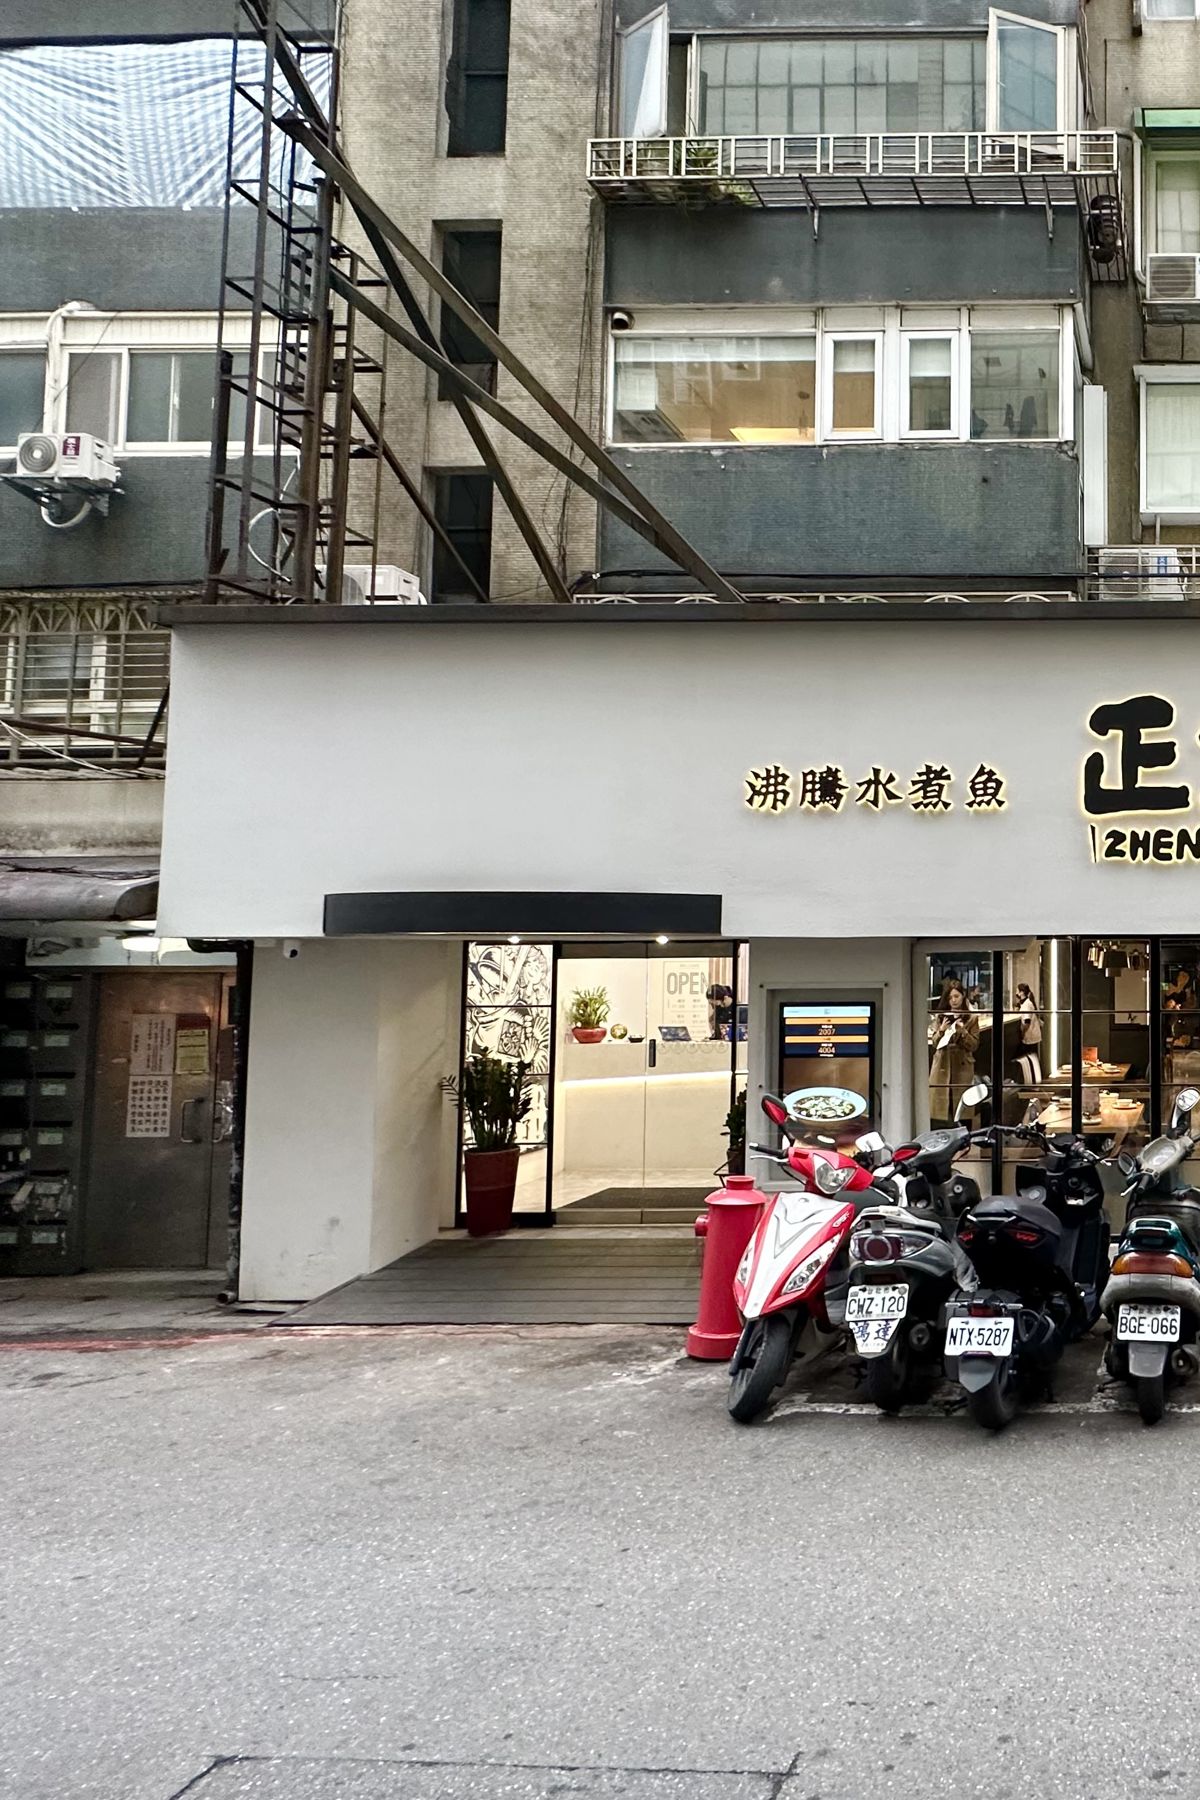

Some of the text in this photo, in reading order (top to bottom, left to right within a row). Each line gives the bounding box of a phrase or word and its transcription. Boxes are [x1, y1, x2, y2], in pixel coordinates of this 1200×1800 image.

[746, 764, 1004, 810] 沸騰水煮魚
